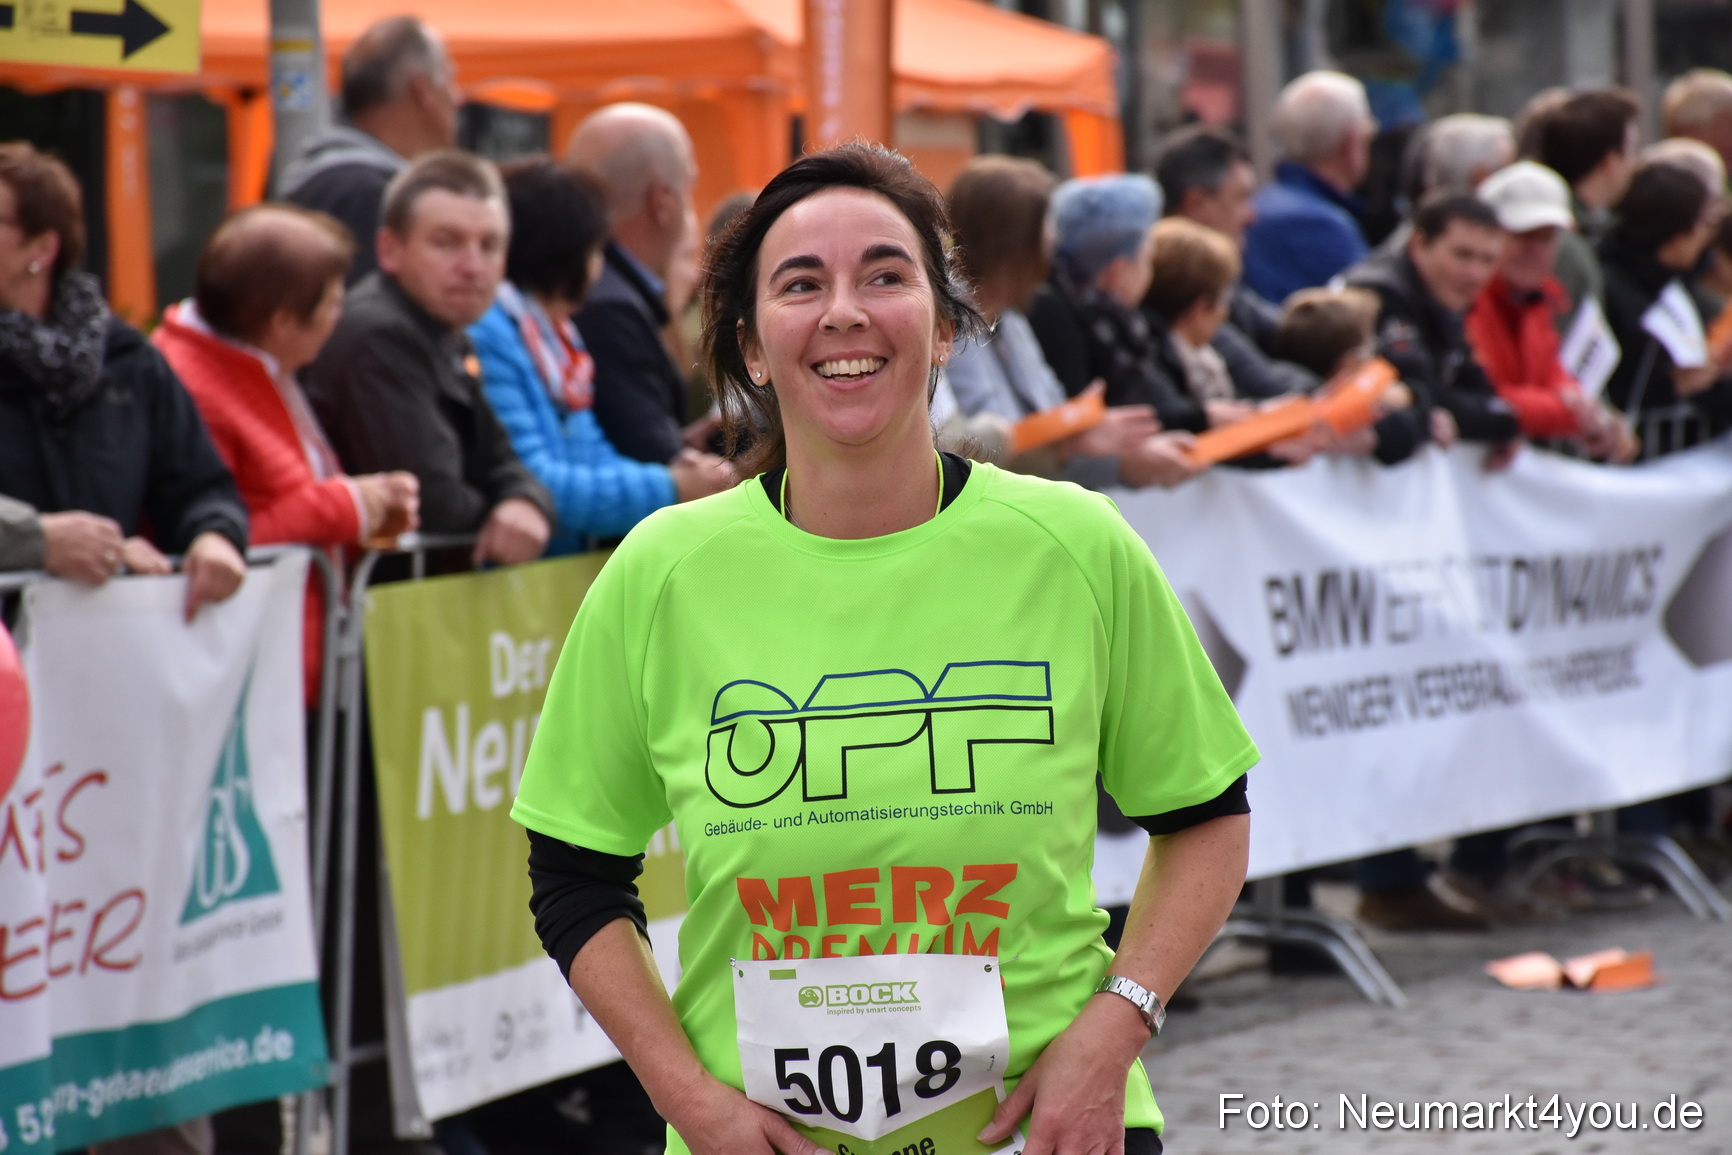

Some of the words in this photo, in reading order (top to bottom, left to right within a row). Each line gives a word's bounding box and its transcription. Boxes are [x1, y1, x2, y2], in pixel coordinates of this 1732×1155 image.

[1265, 568, 1376, 657] BMW
[490, 630, 553, 698] Der
[704, 816, 769, 836] Gebäude-
[773, 813, 803, 829] und
[807, 801, 1005, 825] Automatisierungstechnik
[1010, 800, 1053, 815] GmbH
[736, 863, 1018, 932] MERZ
[826, 982, 920, 1007] BOCK
[826, 1007, 855, 1016] inspired
[856, 1006, 865, 1015] by
[888, 1005, 921, 1013] concepts
[774, 1040, 962, 1123] 5018
